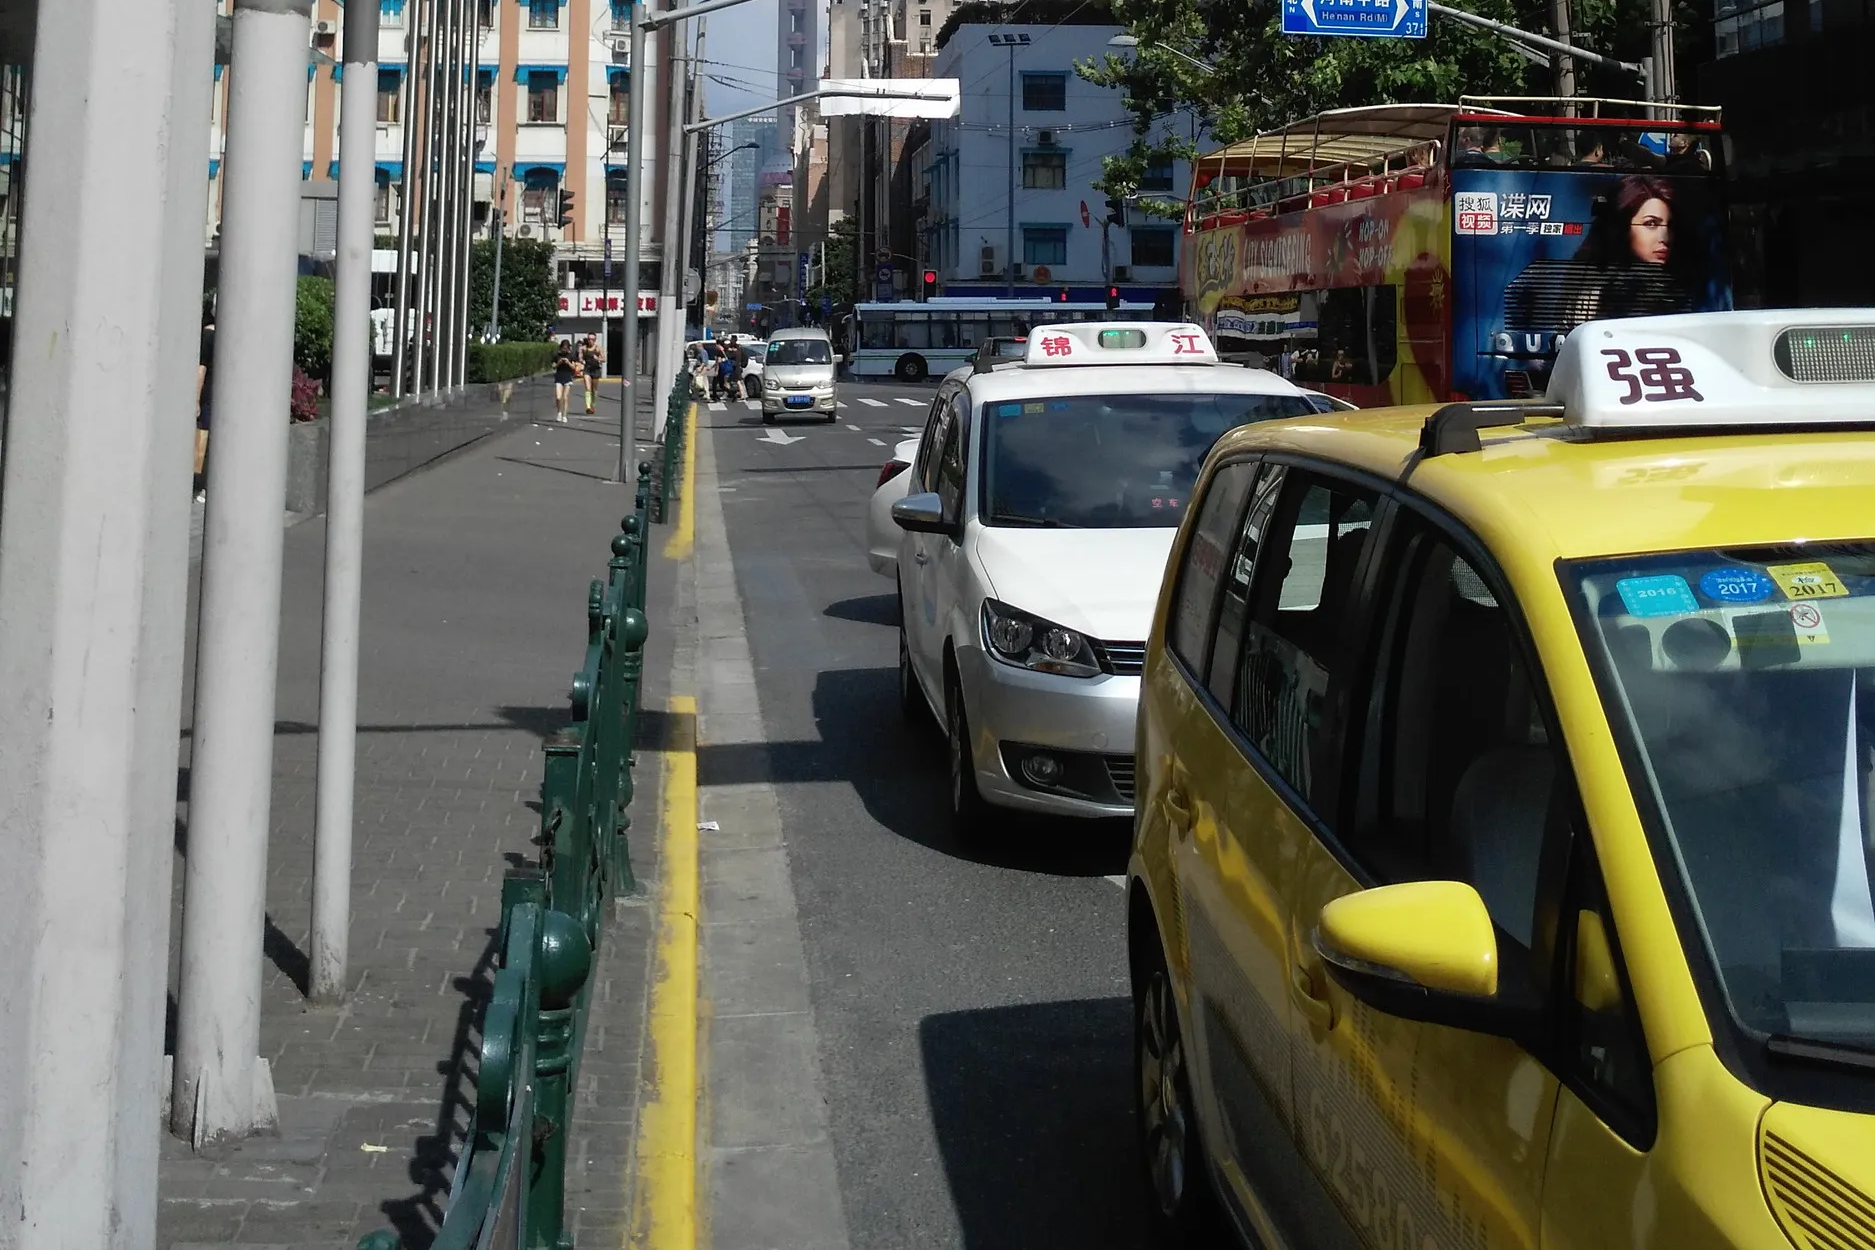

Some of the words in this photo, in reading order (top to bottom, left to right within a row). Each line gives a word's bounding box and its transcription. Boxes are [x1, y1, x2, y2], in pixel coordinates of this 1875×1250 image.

[1459, 196, 1493, 212] 搜狐
[1499, 193, 1552, 220] 谍网
[1460, 214, 1493, 229] 视频
[1500, 221, 1540, 235] 第一季
[1358, 218, 1390, 242] HOP-ON
[1040, 336, 1072, 357] 锦
[1170, 334, 1204, 354] 江
[1600, 347, 1705, 405] 强
[1637, 587, 1677, 598] 2016
[1718, 582, 1757, 595] 2017
[1789, 582, 1837, 597] 2017
